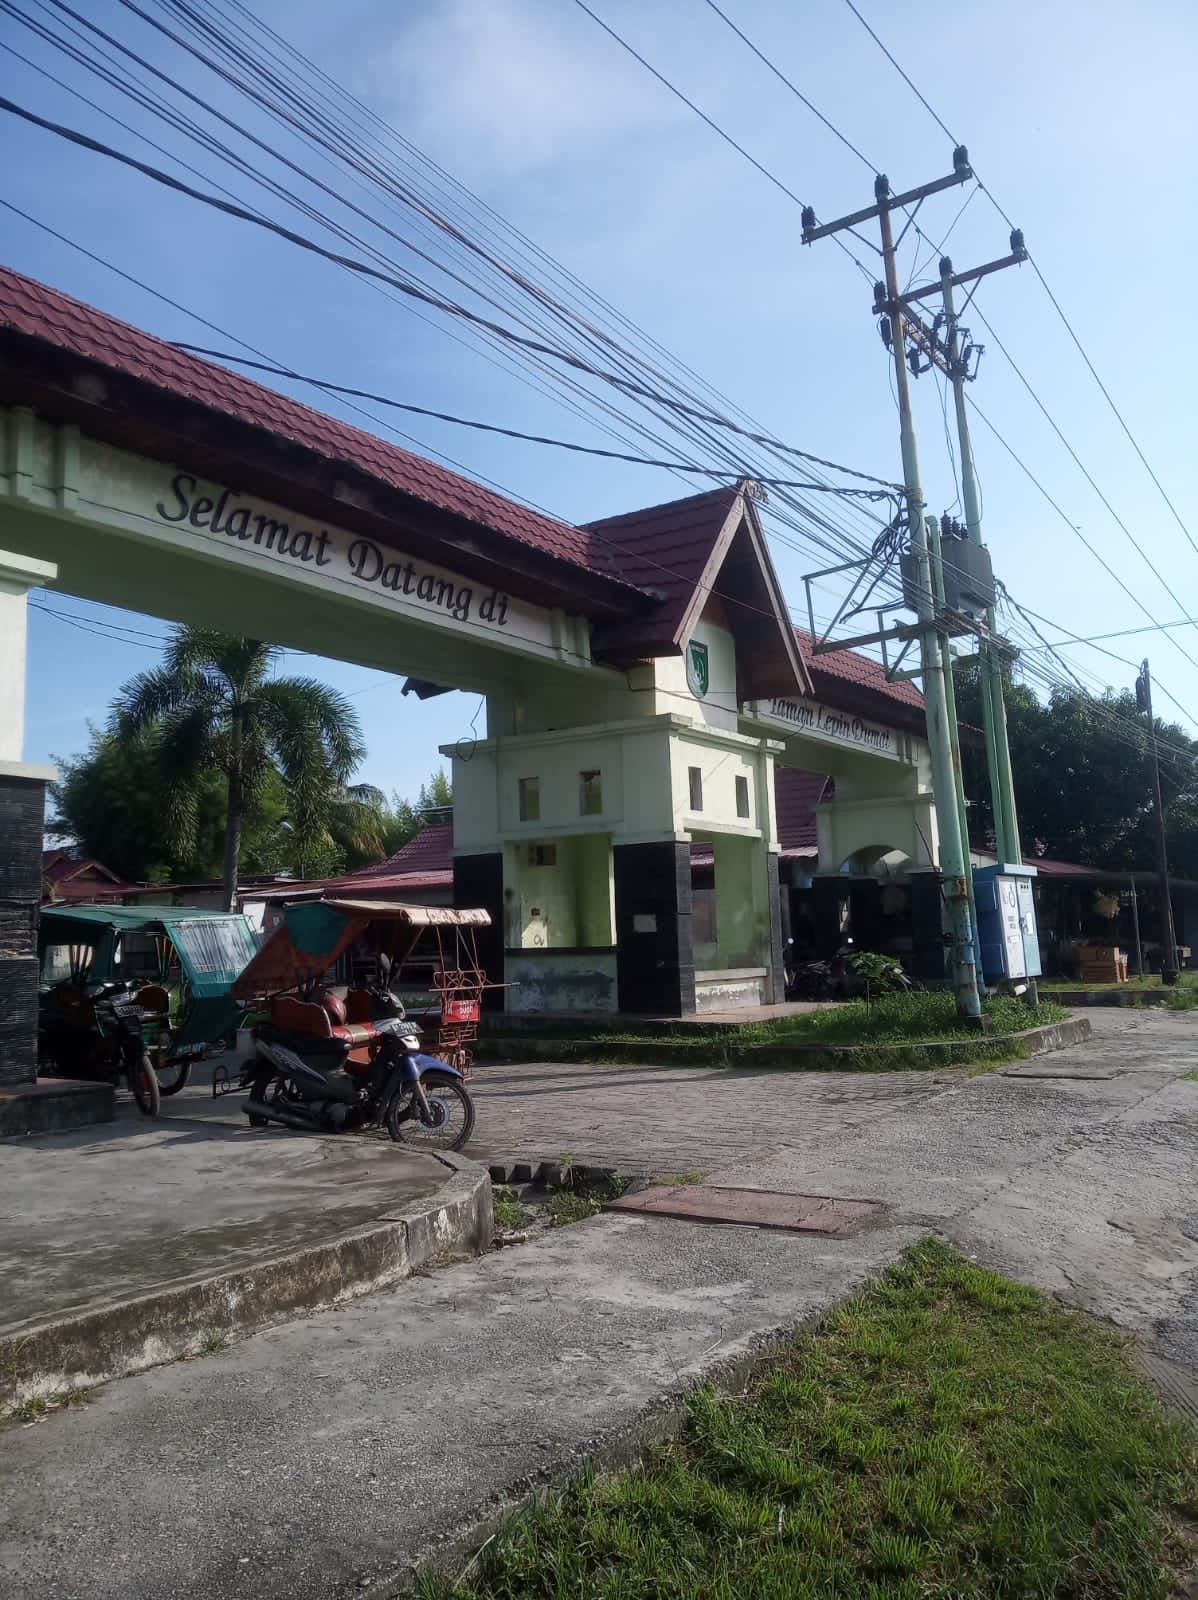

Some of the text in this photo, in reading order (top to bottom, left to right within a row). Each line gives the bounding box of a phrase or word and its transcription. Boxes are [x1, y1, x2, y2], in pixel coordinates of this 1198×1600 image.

[156, 474, 508, 626] Selamat Datang di
[768, 697, 890, 750] Taman Lepin Dumai
